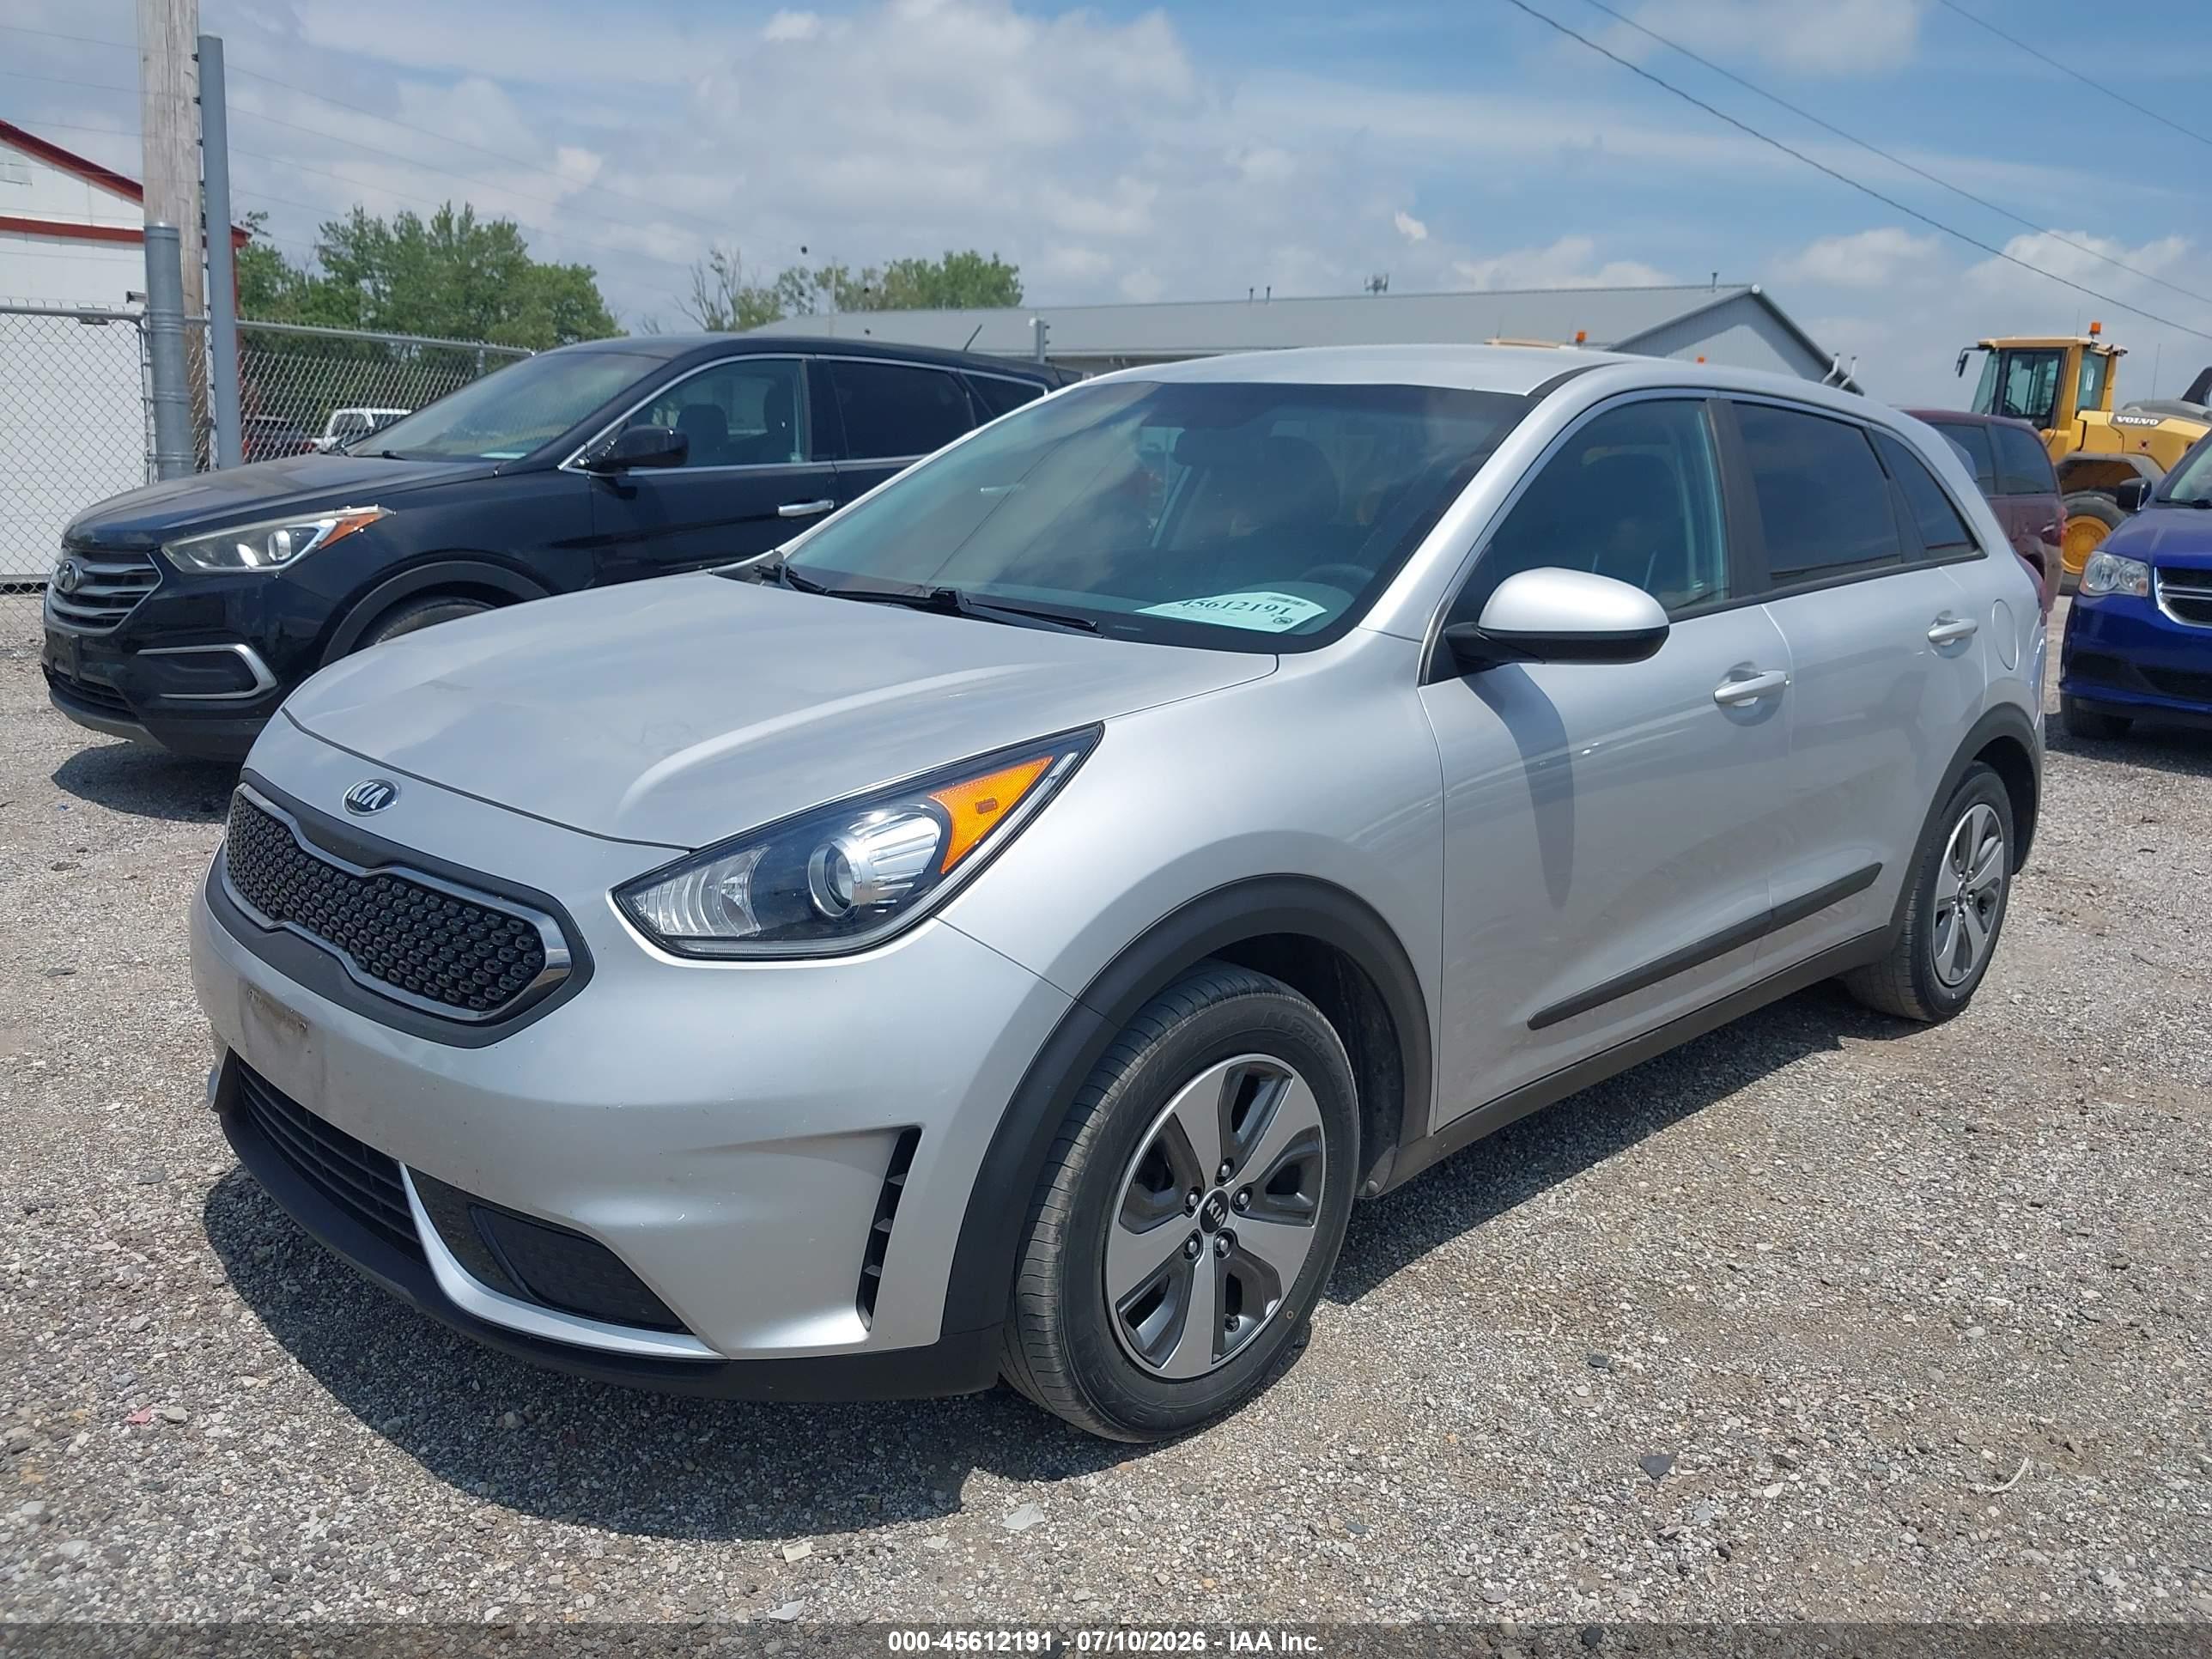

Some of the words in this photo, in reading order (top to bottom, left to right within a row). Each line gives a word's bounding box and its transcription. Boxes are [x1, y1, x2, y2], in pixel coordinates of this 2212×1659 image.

[2117, 416, 2159, 425] VOLVO
[1178, 600, 1291, 615] 45612191
[348, 781, 389, 809] KIA
[1206, 1198, 1225, 1226] KIA
